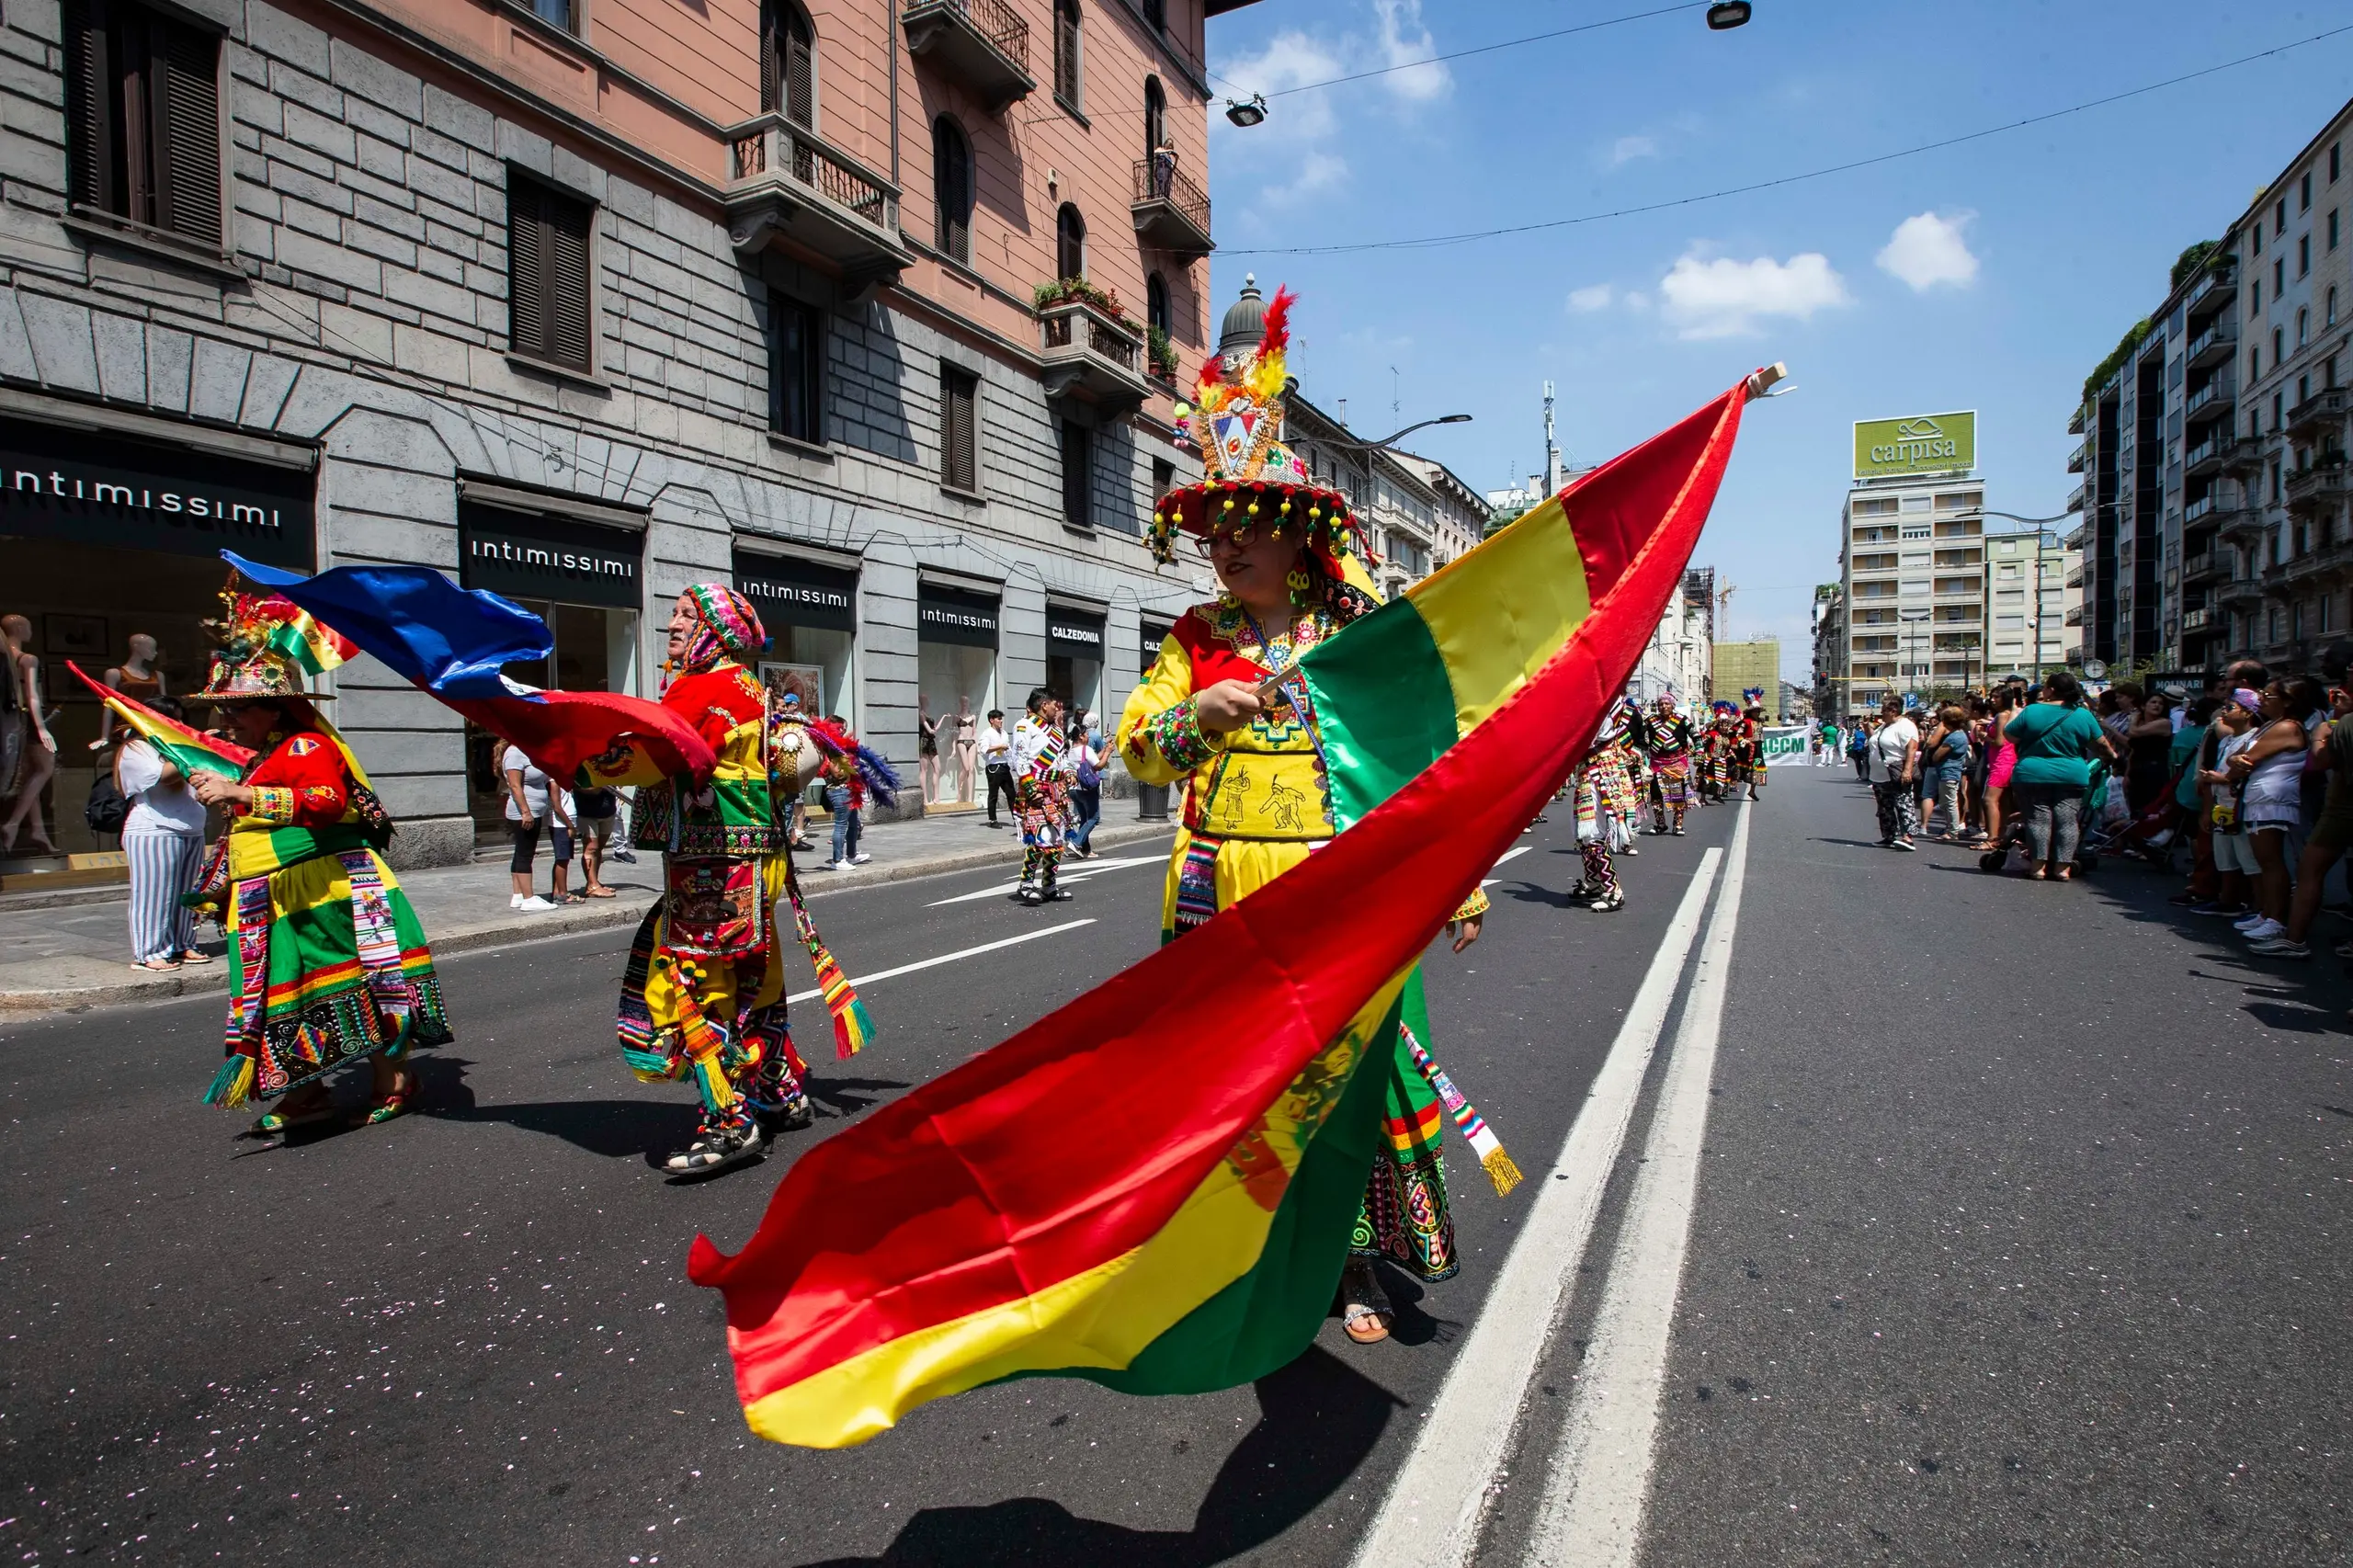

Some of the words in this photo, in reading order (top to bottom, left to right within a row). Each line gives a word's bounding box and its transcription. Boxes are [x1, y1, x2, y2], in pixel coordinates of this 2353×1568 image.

[1871, 440, 1956, 466] carpisa
[472, 540, 631, 577] intimissimi
[744, 581, 847, 607] intimissimi
[923, 609, 995, 630] intimissimi
[1051, 626, 1099, 643] CALZEDONIA
[1144, 641, 1162, 652] CALZ
[1908, 694, 1915, 702] P
[88, 854, 126, 867] int
